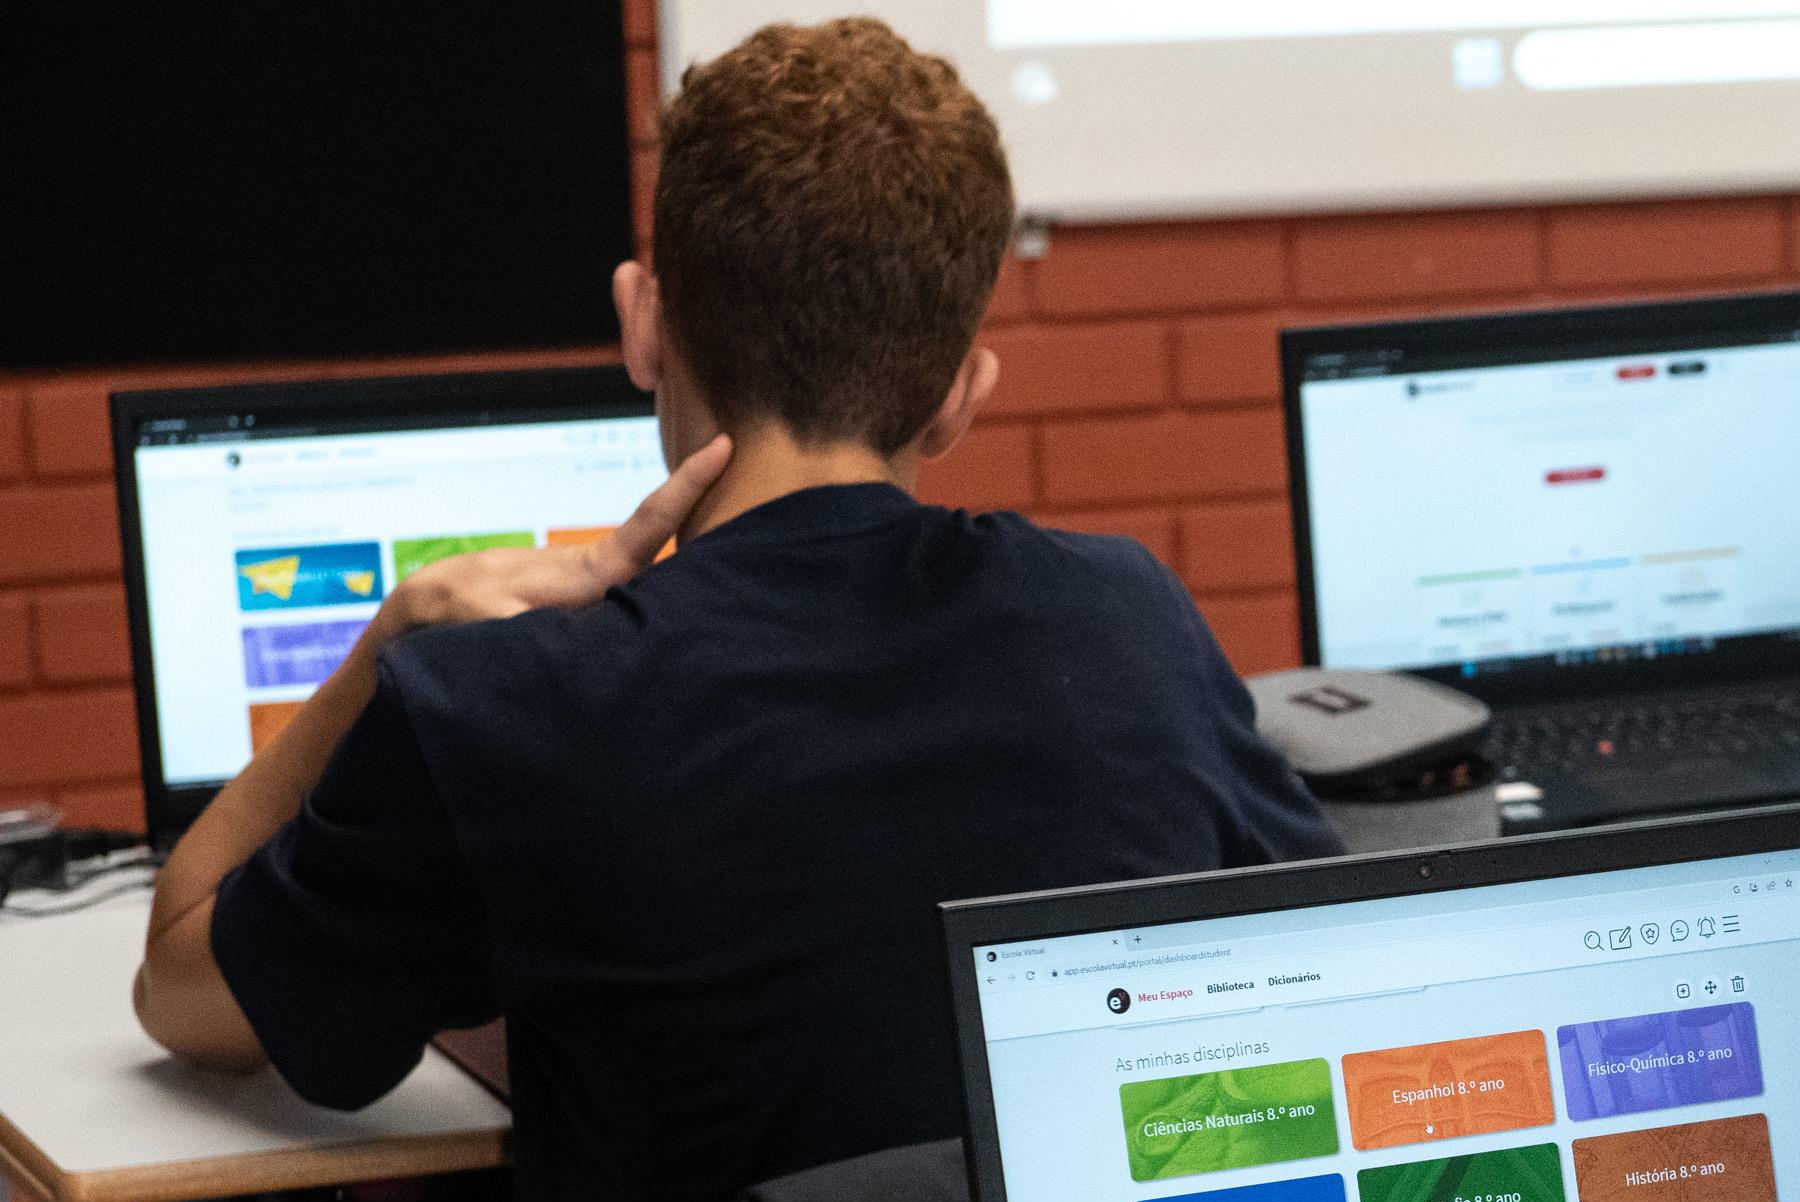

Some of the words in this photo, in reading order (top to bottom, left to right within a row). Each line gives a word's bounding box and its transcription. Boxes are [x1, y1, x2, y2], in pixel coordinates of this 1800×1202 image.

[1207, 978, 1255, 995] Biblioteca
[1268, 970, 1321, 988] Dicionários
[1138, 991, 1158, 1004] Meu
[1160, 986, 1193, 1003] Espaço
[1115, 1057, 1133, 1073] As
[1136, 1050, 1190, 1070] minhas
[1193, 1039, 1270, 1066] disciplinas
[1588, 1051, 1685, 1077] Físico-Química
[1687, 1049, 1705, 1065] 8.º
[1707, 1046, 1733, 1060] ano
[1392, 1082, 1455, 1104] Espanhol
[1458, 1080, 1476, 1096] 8.º
[1479, 1077, 1505, 1092] ano
[1143, 1118, 1203, 1138] Ciências
[1206, 1110, 1265, 1130] Naturais
[1267, 1105, 1286, 1121] 8.º
[1289, 1103, 1315, 1118] ano
[1625, 1165, 1678, 1187] História
[1680, 1163, 1698, 1179] 8.º
[1700, 1161, 1725, 1176] ano
